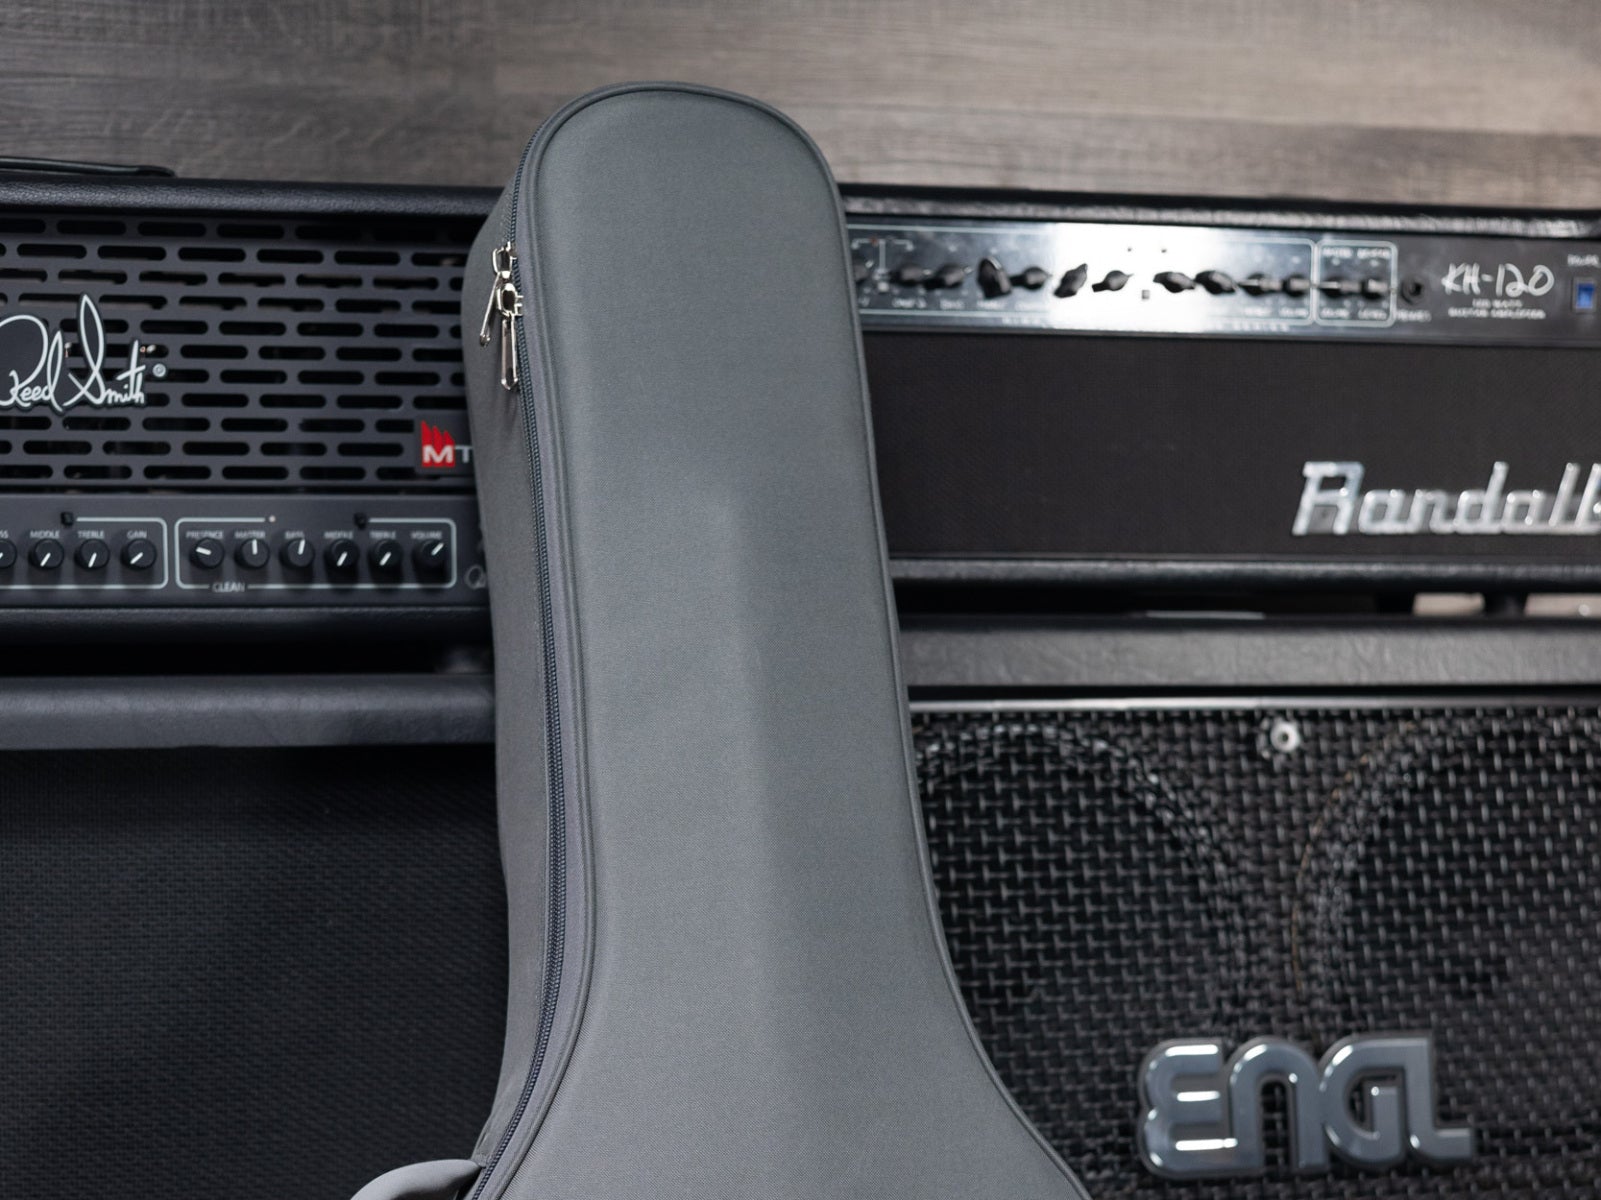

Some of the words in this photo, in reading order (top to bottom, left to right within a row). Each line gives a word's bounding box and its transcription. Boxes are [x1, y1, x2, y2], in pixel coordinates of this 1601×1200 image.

[1441, 262, 1555, 298] KH-120
[63, 294, 147, 405] Smith
[30, 530, 60, 539] MIDDLE
[77, 530, 105, 539] TREBLE
[126, 530, 147, 539] GAIN
[185, 530, 224, 539] PRESENCE
[410, 530, 442, 539] VOLUME
[212, 581, 246, 593] CLEAN
[1140, 1033, 1474, 1176] ENGL
